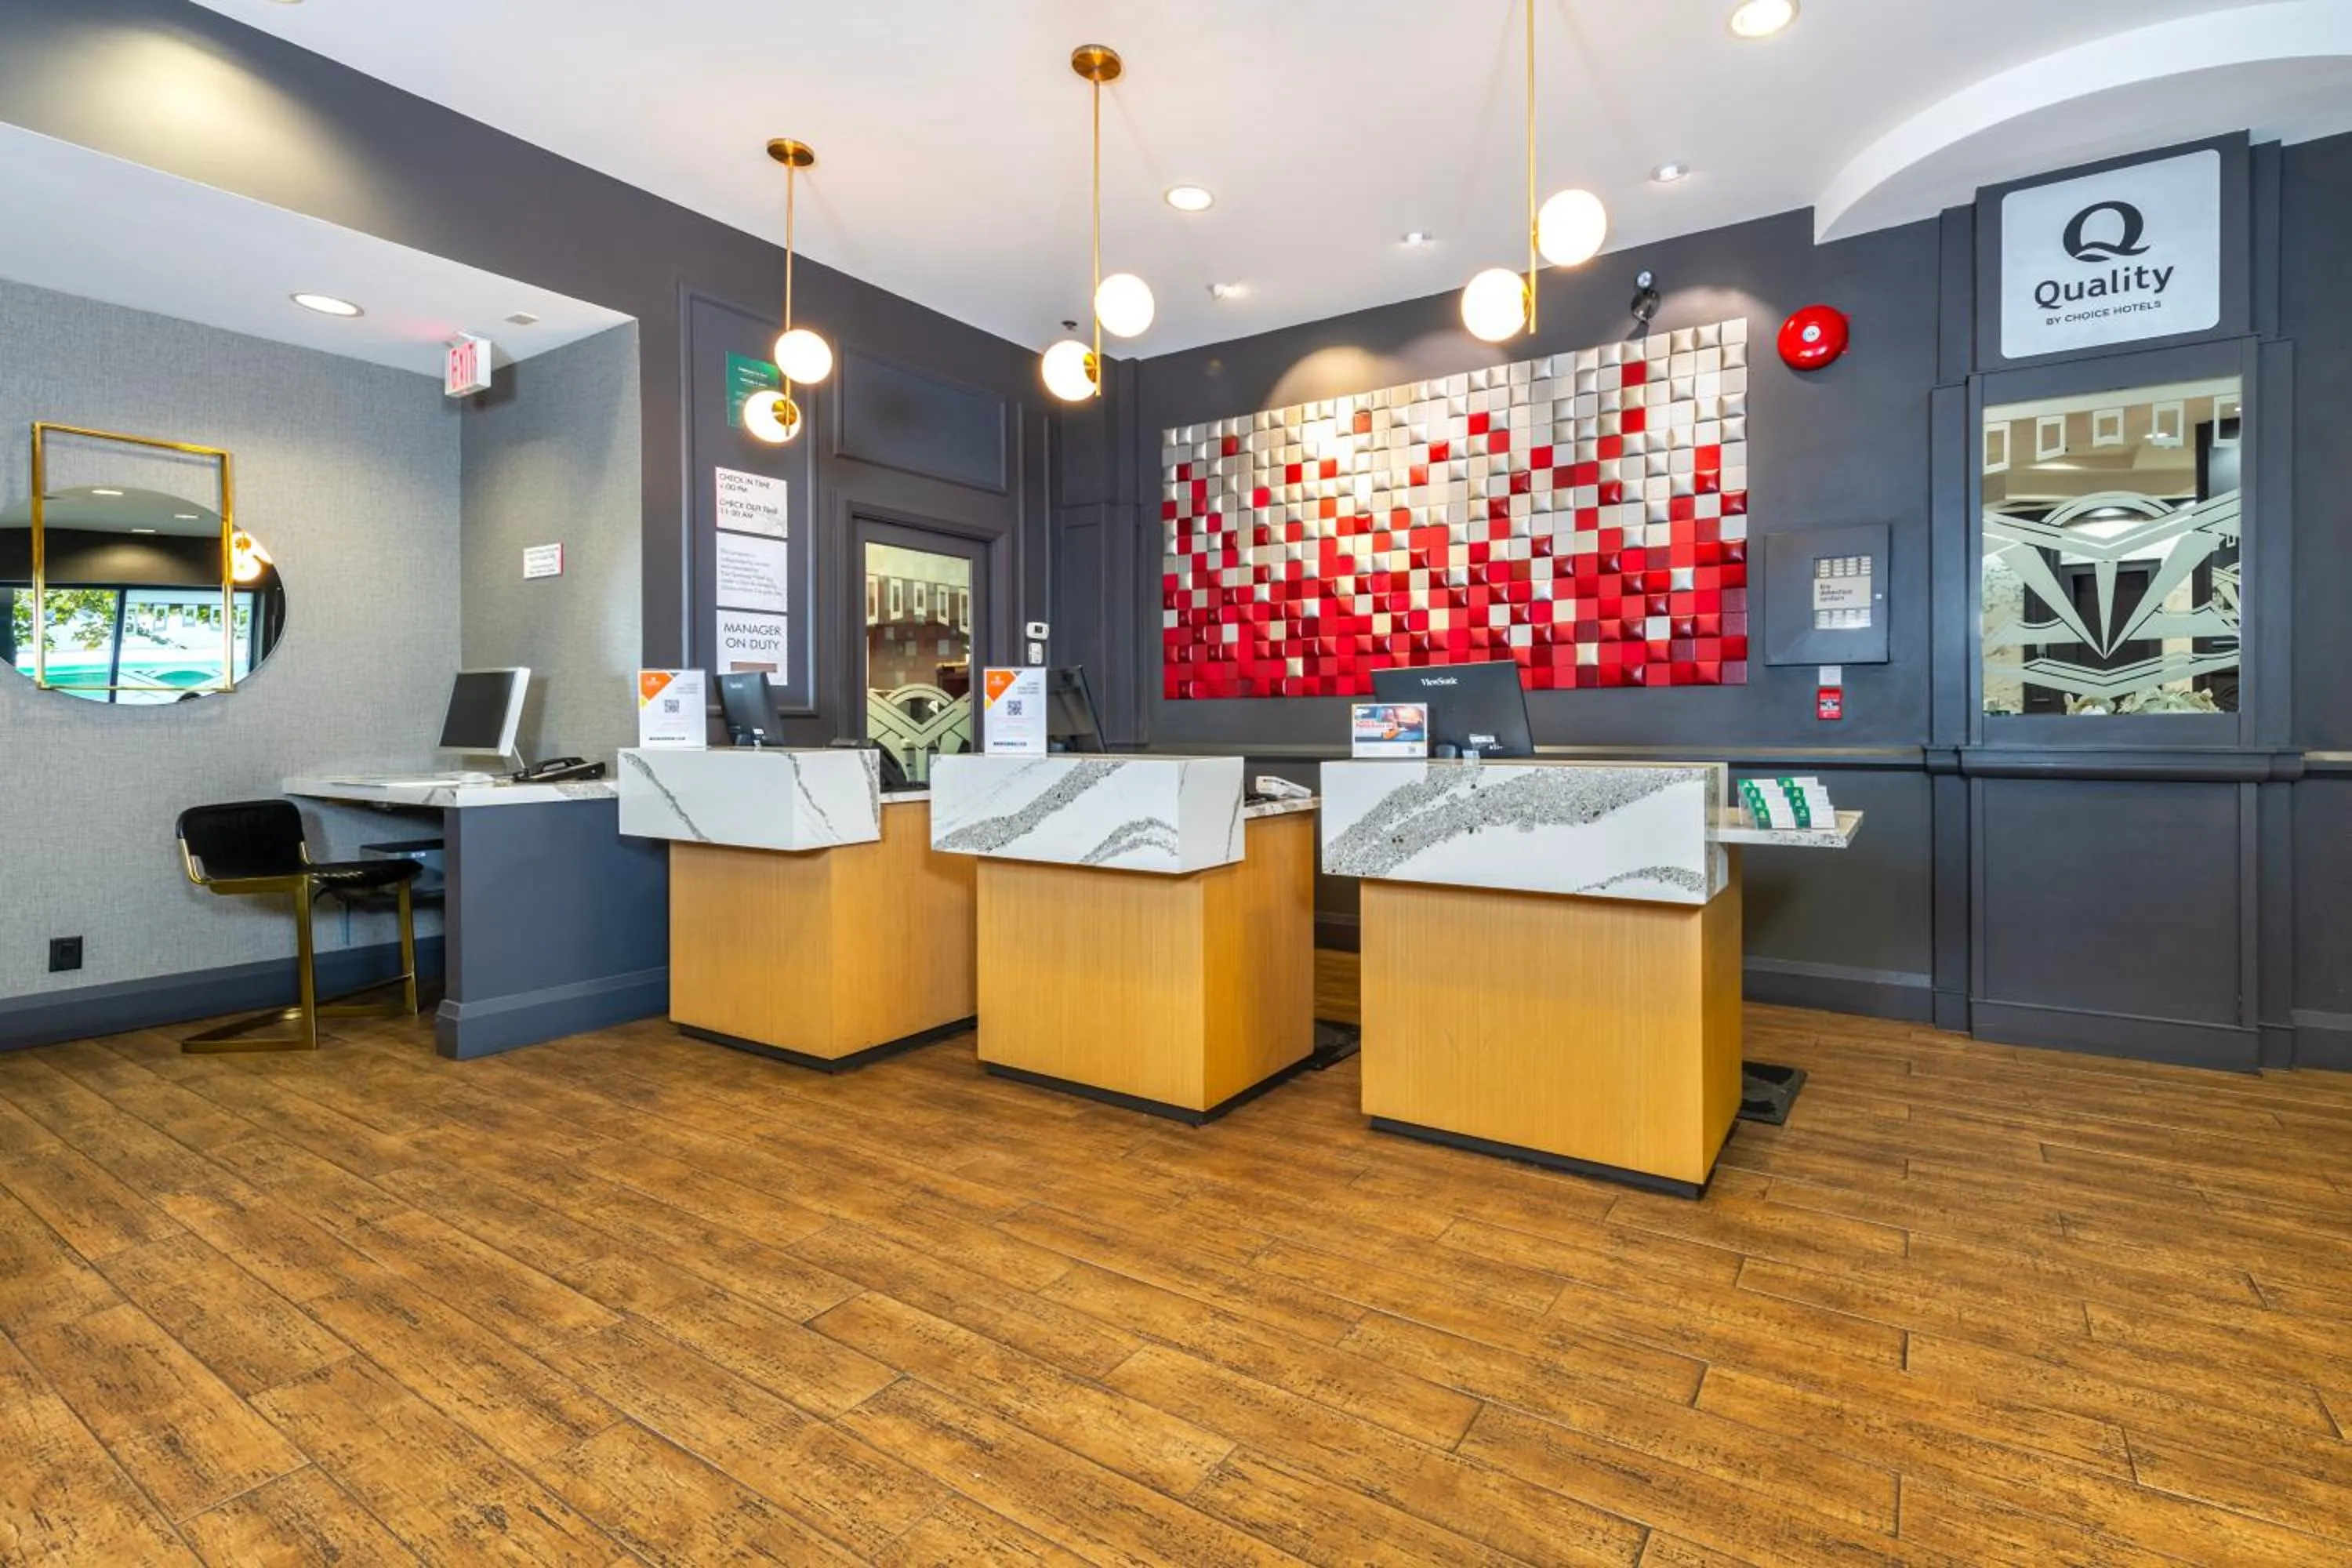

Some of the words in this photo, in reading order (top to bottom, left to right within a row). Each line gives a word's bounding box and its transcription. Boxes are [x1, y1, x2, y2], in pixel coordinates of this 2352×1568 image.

[2063, 200, 2151, 263] Q
[2034, 266, 2174, 310] Quality
[2045, 315, 2062, 325] BY
[2064, 309, 2110, 323] CHOICE
[2113, 300, 2161, 314] HOTELS
[452, 343, 477, 389] EXIT
[719, 473, 743, 484] CHECK
[719, 499, 743, 510] CHECK
[746, 503, 761, 512] OUT
[724, 623, 782, 637] MANAGER
[725, 637, 746, 648] ON
[750, 639, 779, 650] DUTY
